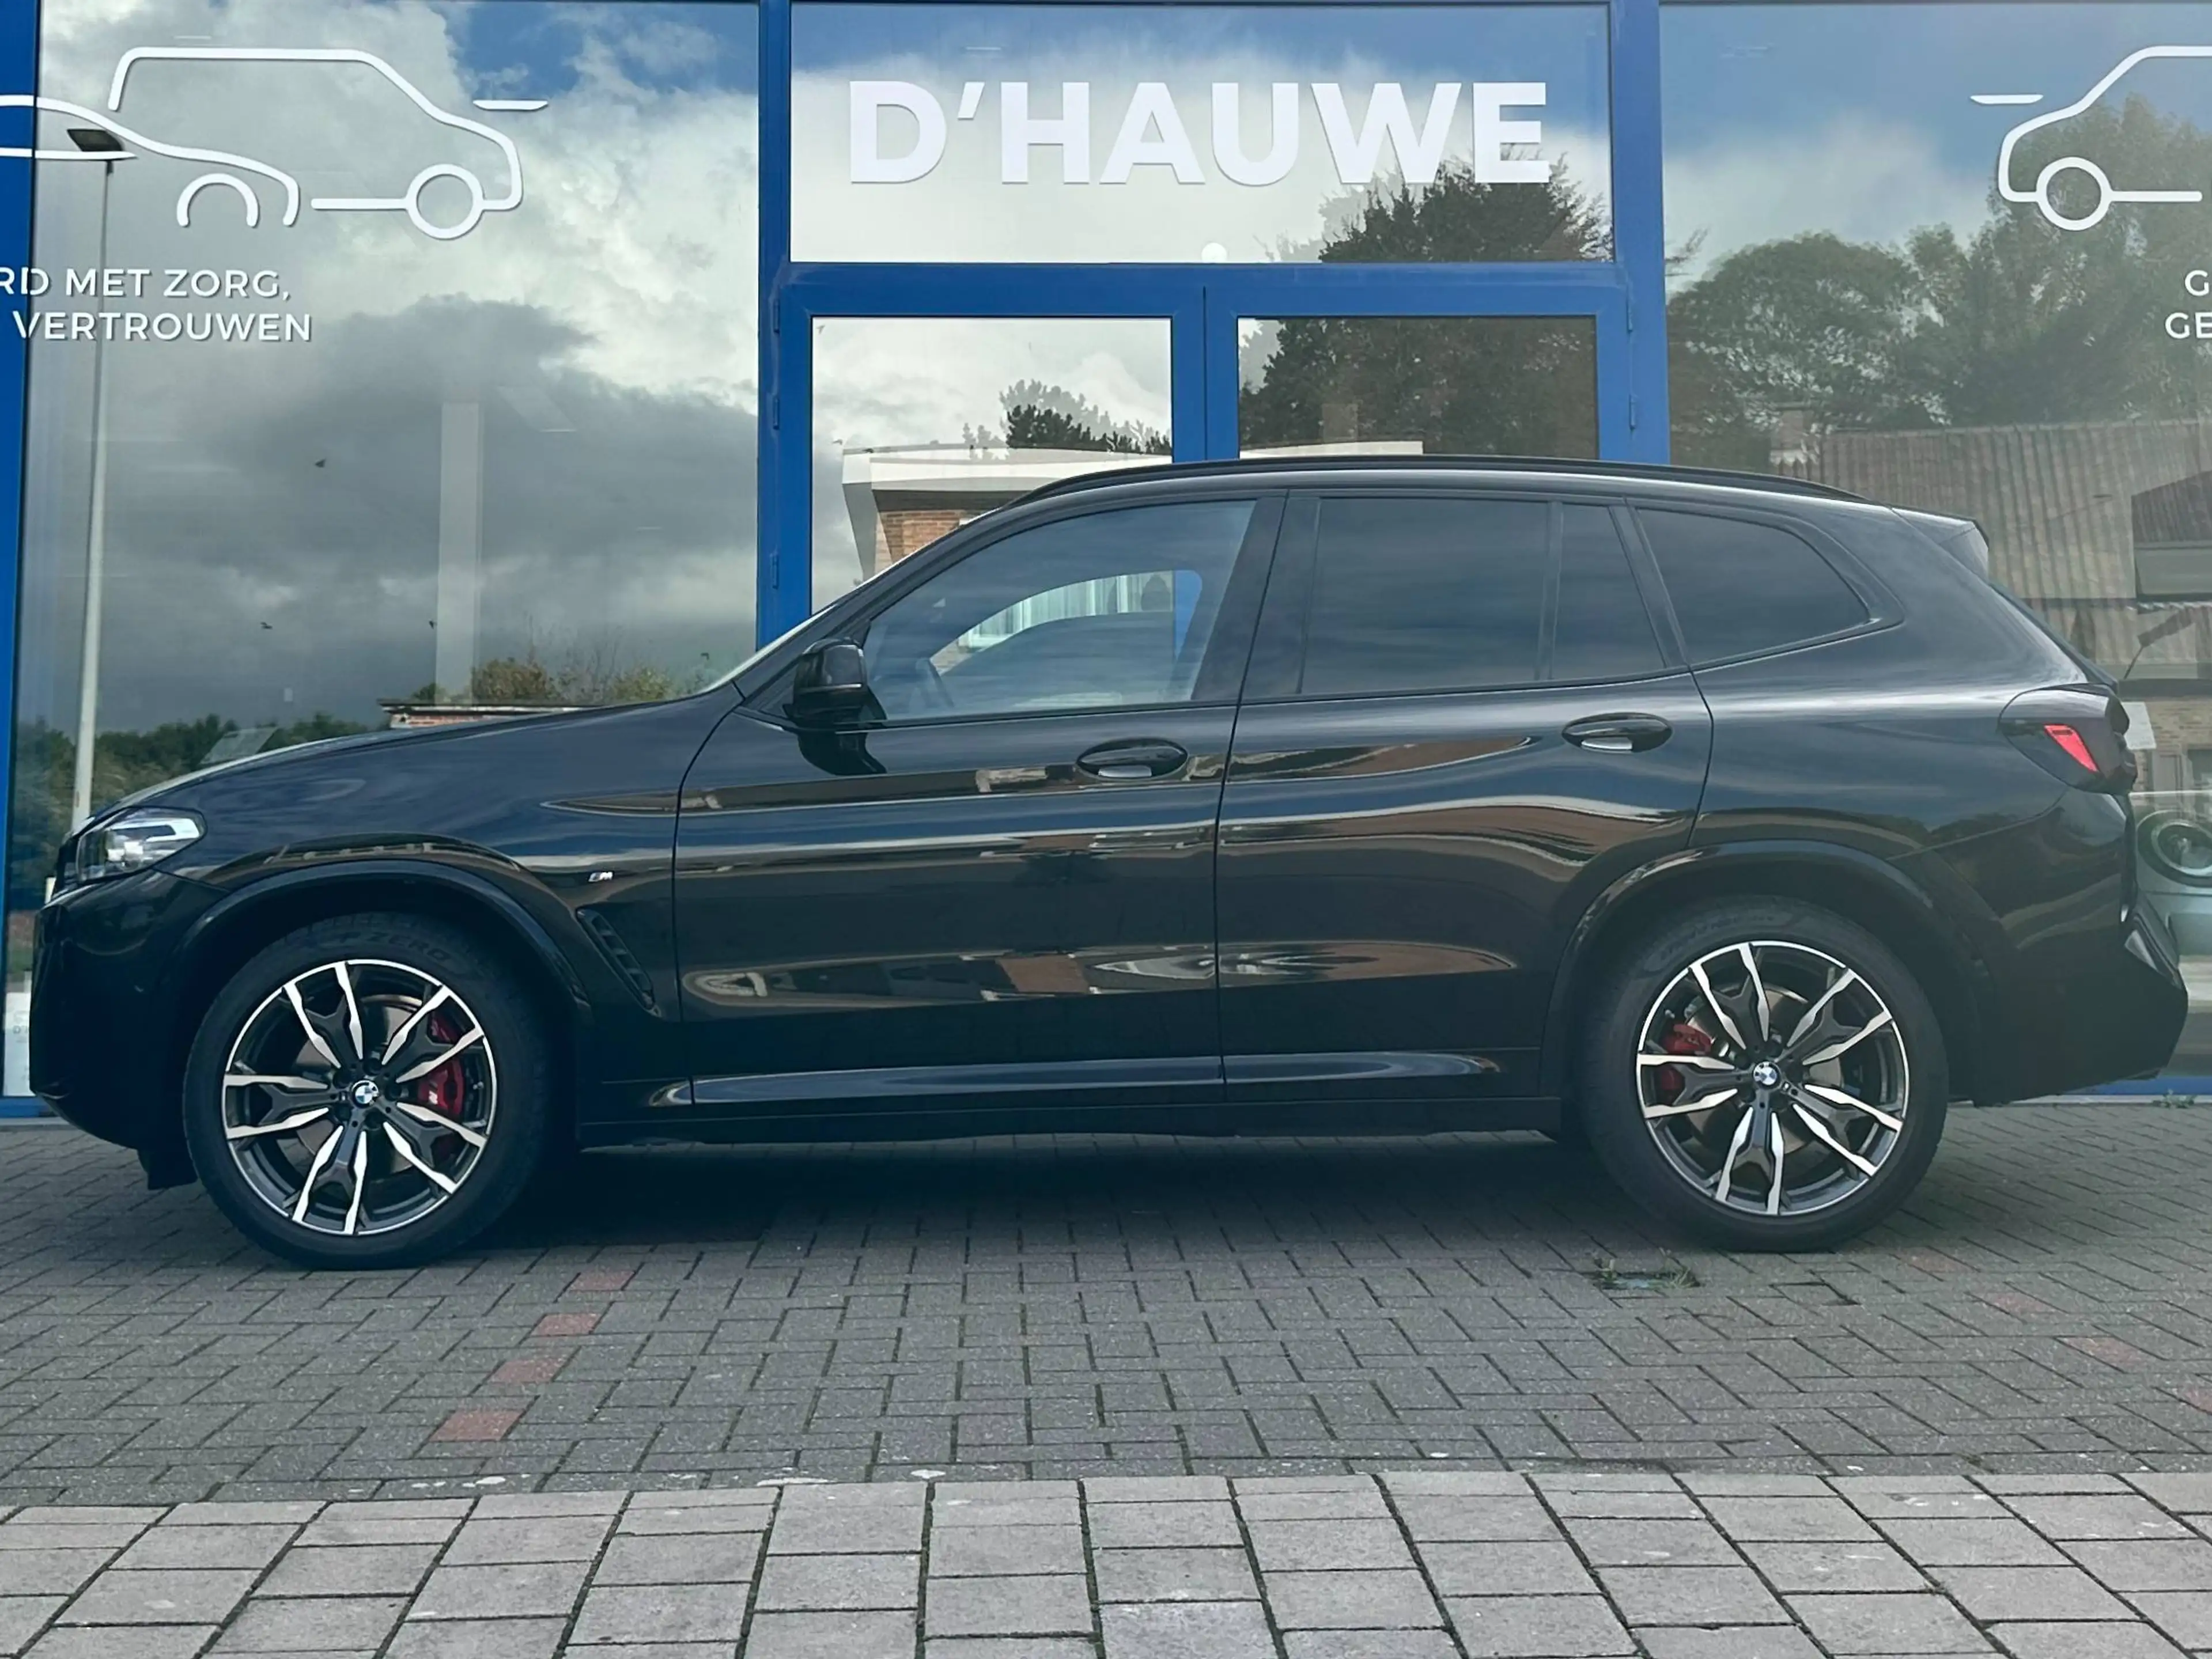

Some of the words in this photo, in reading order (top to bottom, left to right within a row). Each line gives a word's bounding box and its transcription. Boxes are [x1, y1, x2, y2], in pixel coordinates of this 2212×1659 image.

[850, 81, 1549, 185] D'HAUWE
[66, 268, 150, 297] MET
[163, 269, 289, 301] ZORG,
[12, 310, 310, 341] VERTROUWEN
